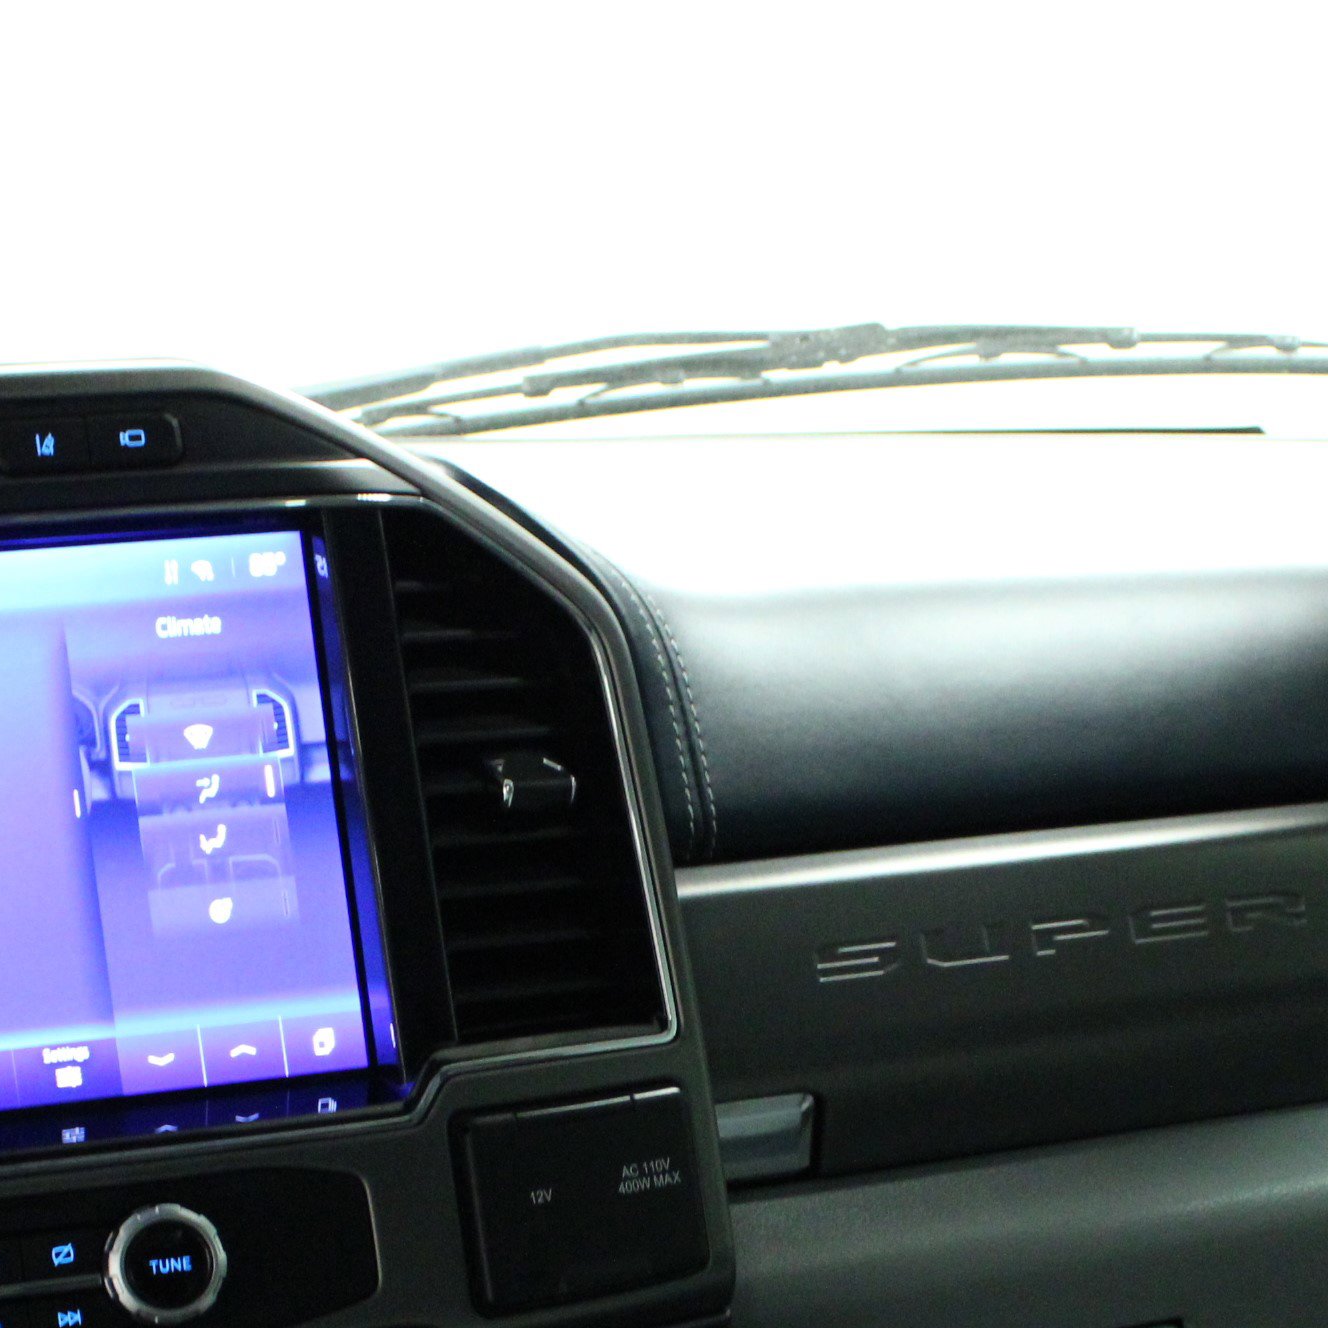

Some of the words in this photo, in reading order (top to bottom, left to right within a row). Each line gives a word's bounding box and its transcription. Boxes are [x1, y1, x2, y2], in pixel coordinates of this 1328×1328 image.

[155, 615, 222, 638] Climate
[814, 892, 1308, 984] SUPER
[41, 1045, 90, 1064] Settings
[622, 1164, 639, 1178] AC
[642, 1156, 671, 1175] 110V
[617, 1178, 652, 1195] 400W
[654, 1170, 682, 1188] MAX
[529, 1188, 553, 1205] 12V
[149, 1255, 192, 1275] TUNE
